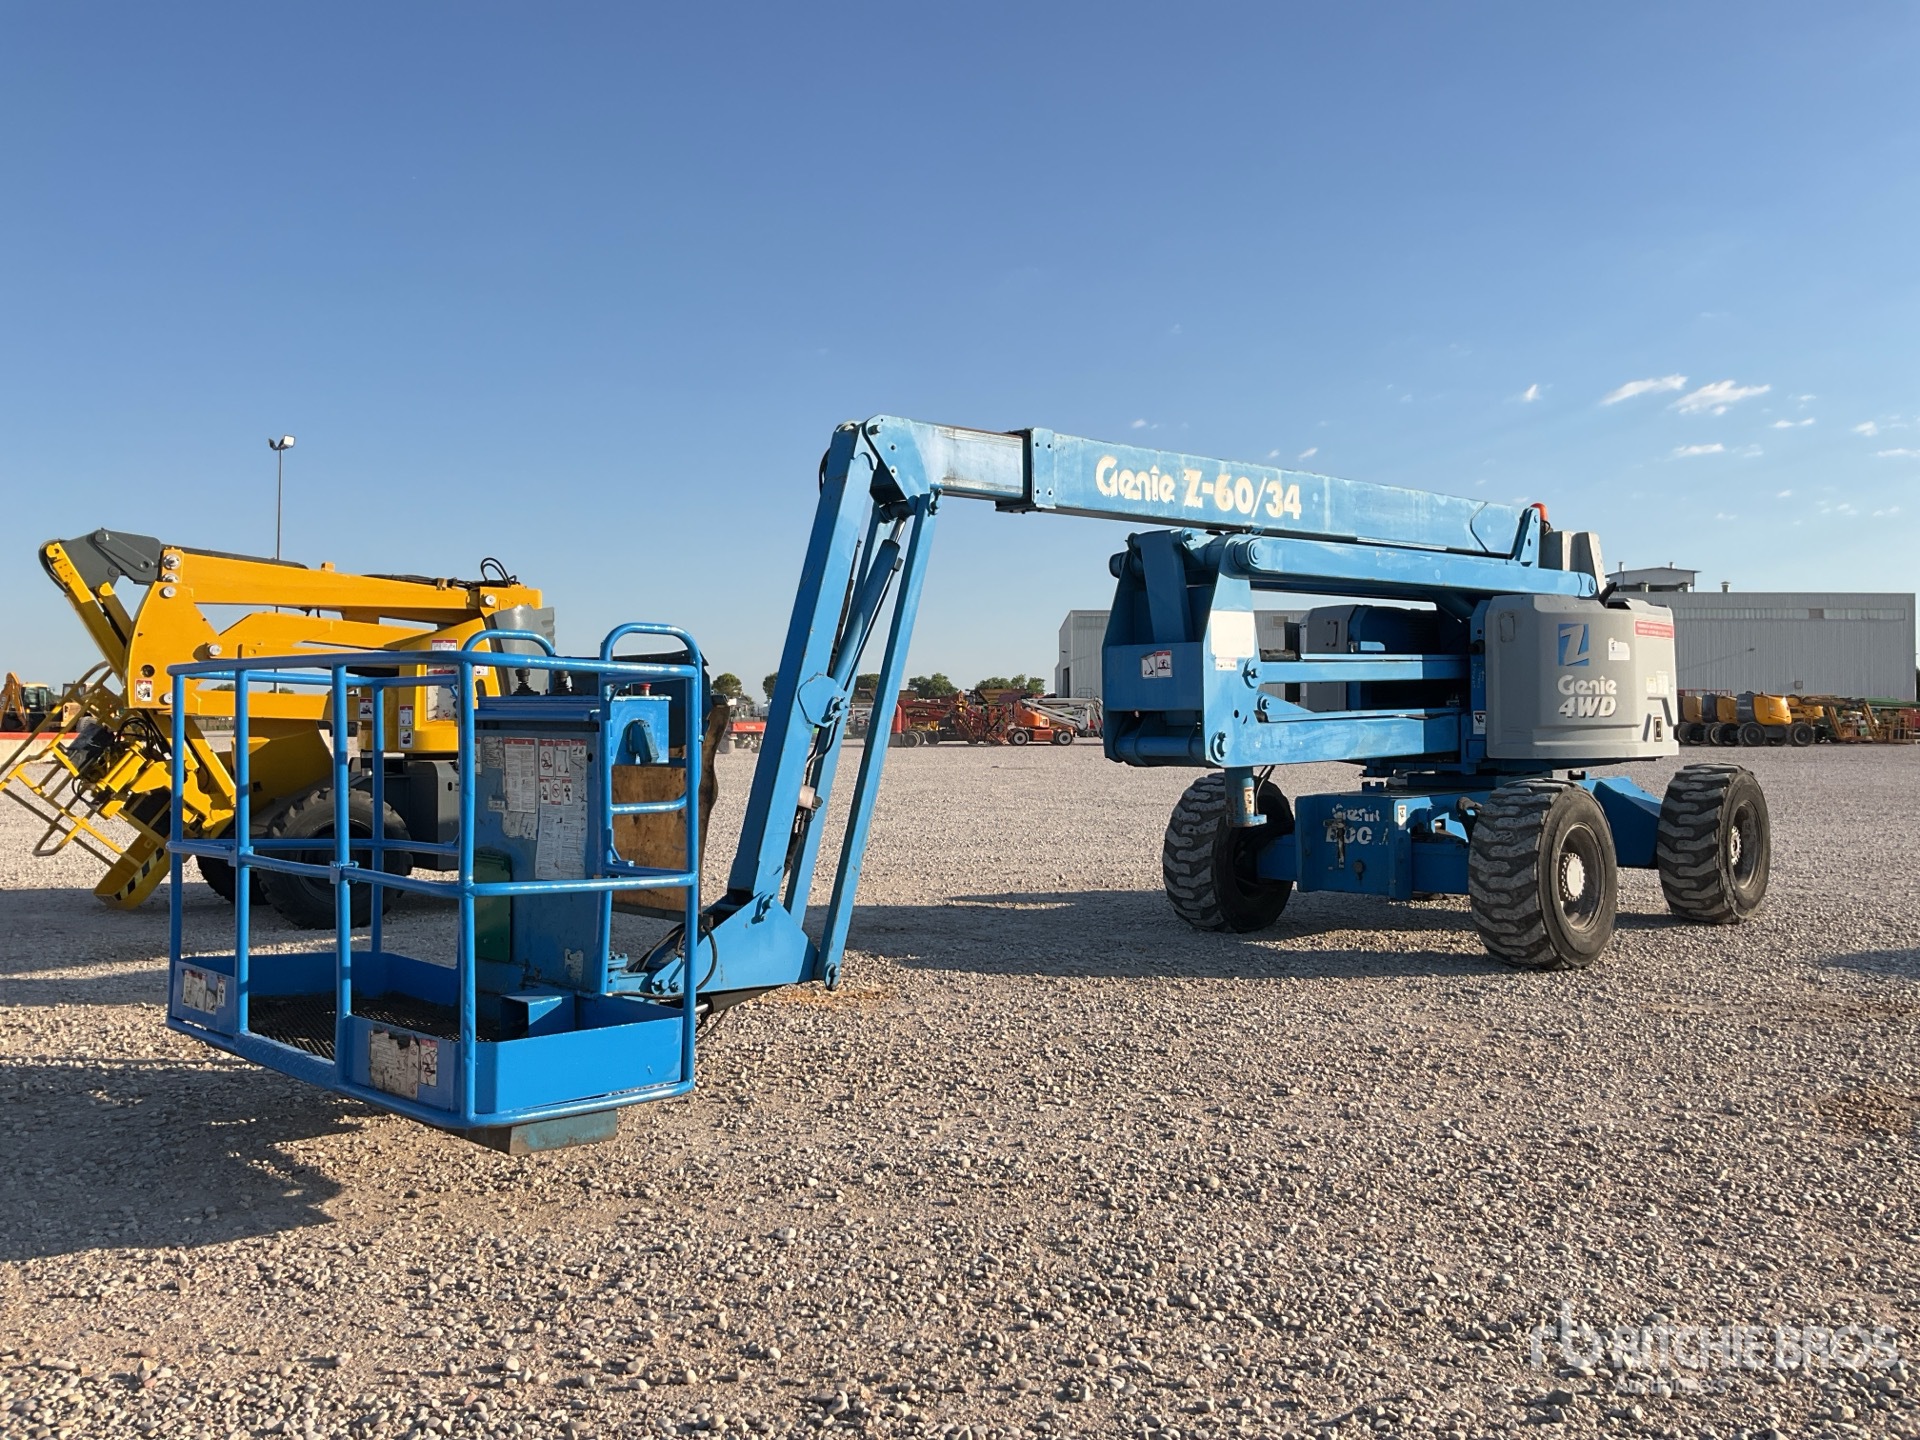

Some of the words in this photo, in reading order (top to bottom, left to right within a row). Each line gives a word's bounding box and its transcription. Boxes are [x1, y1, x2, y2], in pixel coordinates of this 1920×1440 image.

[1096, 455, 1176, 503] Genie
[1184, 469, 1301, 519] Z-60/34
[1559, 624, 1589, 666] Z
[1558, 675, 1617, 695] Genie
[1558, 697, 1617, 718] 4WD
